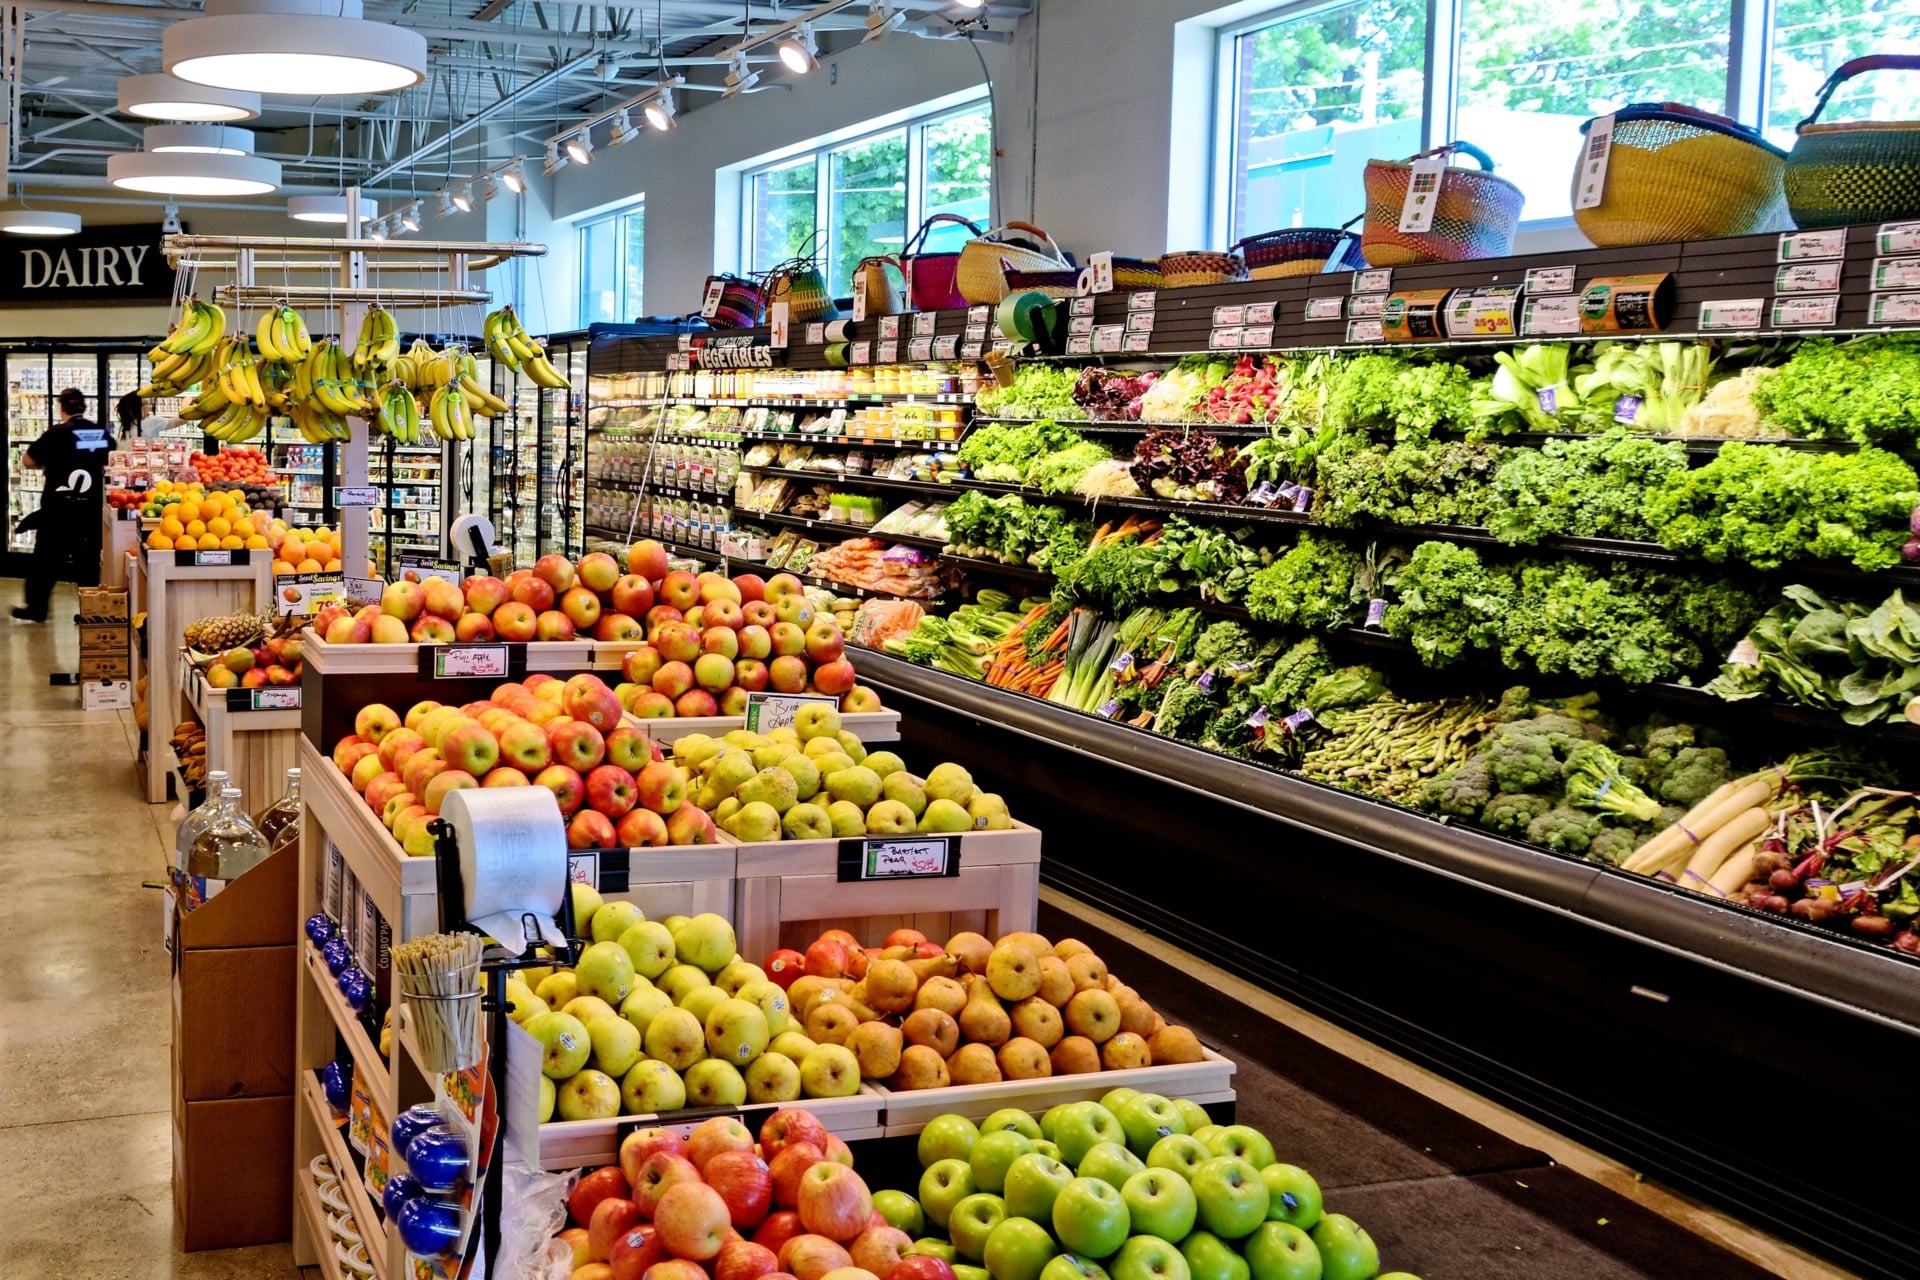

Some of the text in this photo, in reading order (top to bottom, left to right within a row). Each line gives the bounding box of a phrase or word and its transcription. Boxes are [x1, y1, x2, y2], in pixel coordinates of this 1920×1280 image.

[20, 245, 150, 289] DAIRY
[697, 345, 773, 369] VEGETABLES
[312, 573, 343, 584] Savings!
[380, 937, 389, 969] COMBO
